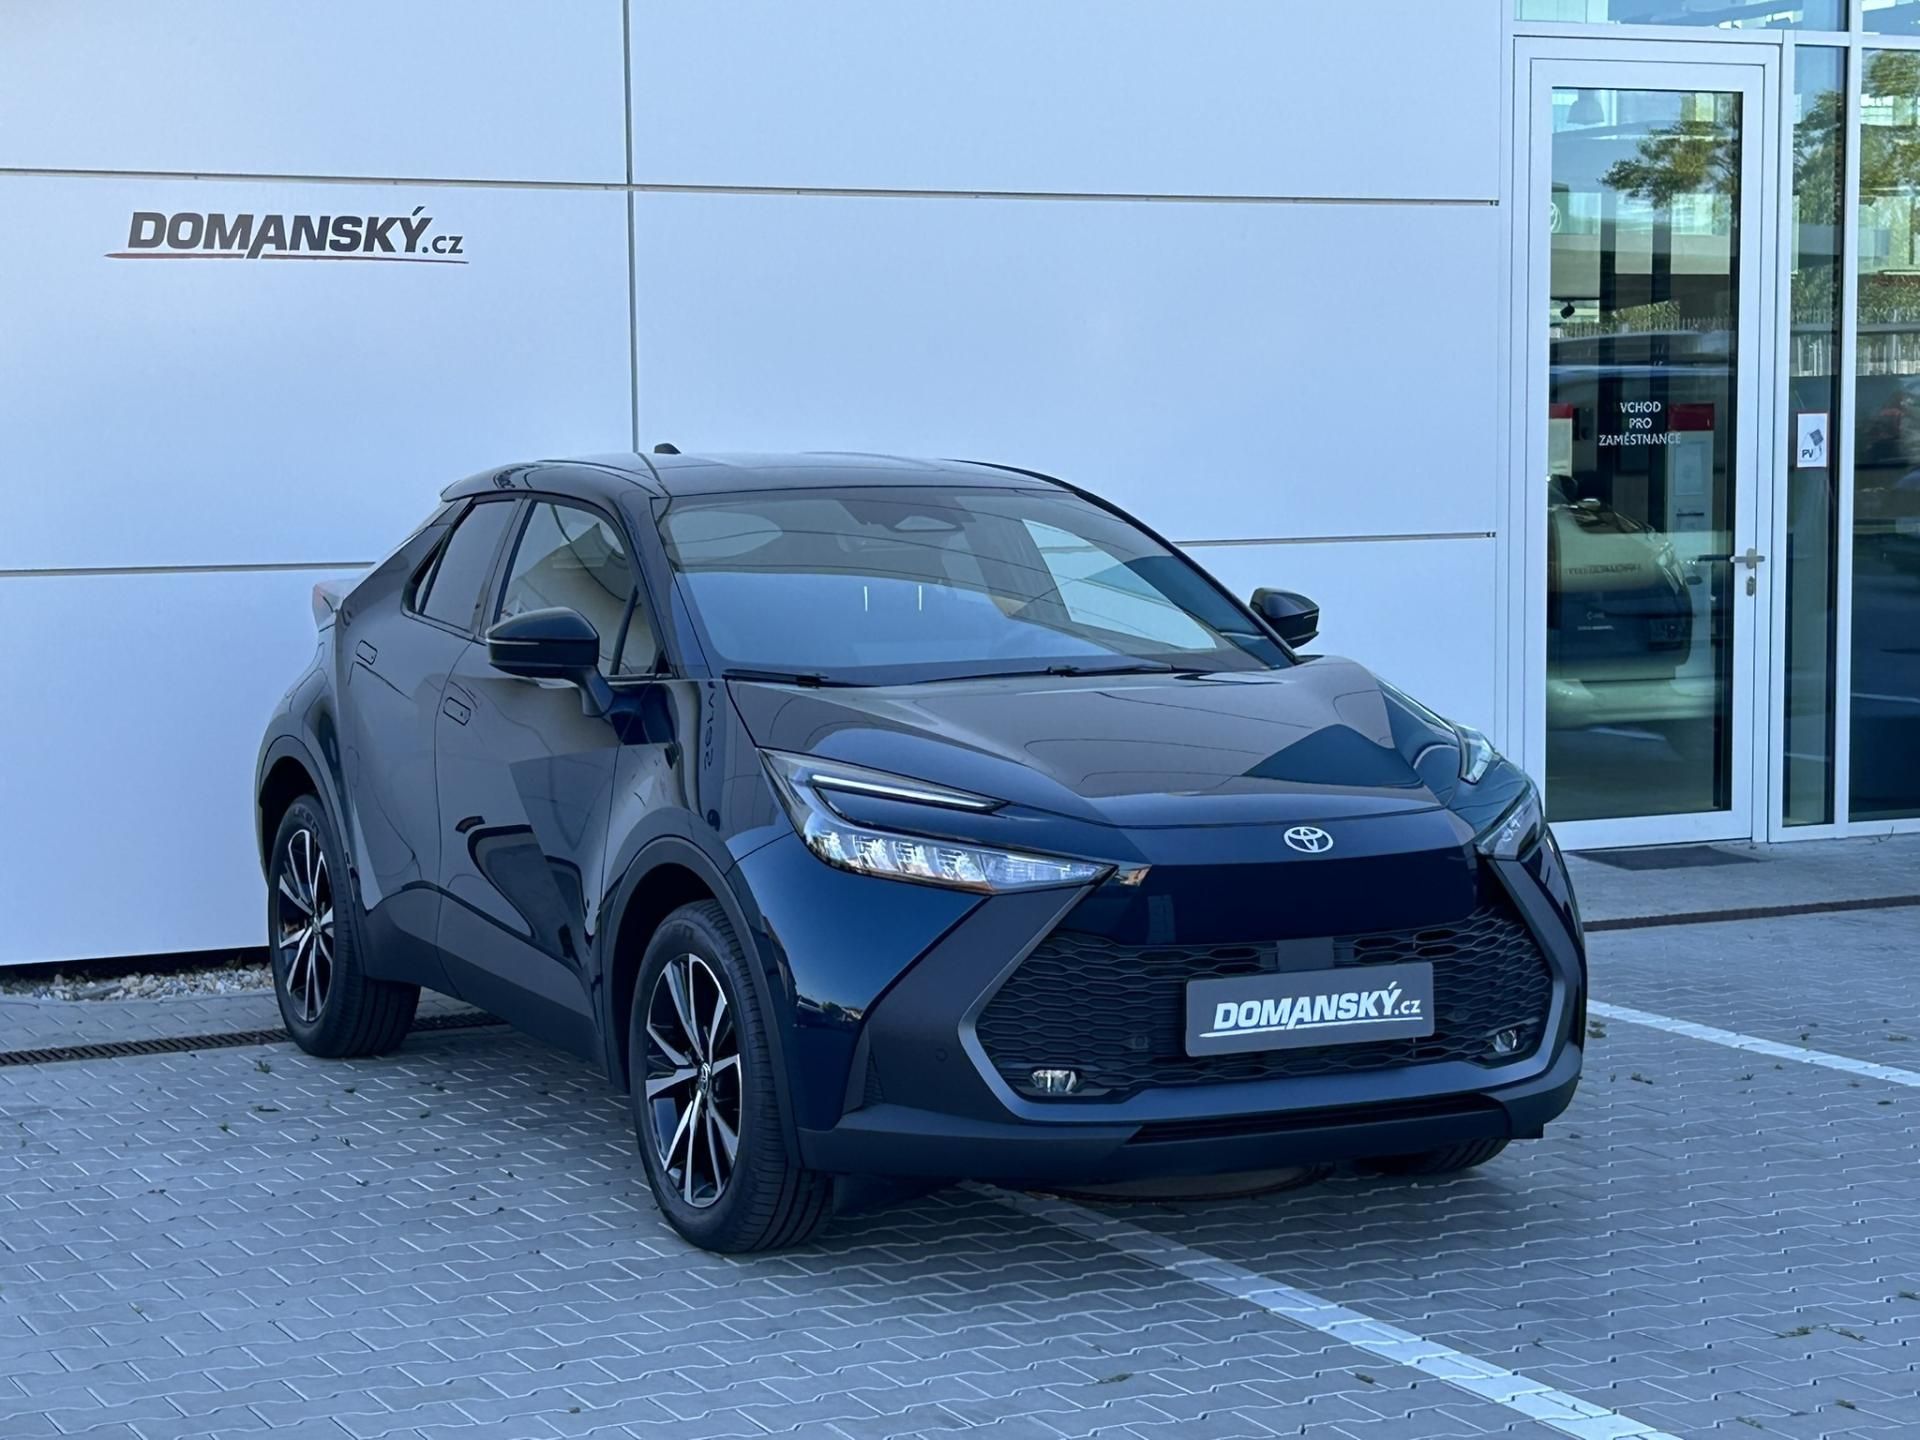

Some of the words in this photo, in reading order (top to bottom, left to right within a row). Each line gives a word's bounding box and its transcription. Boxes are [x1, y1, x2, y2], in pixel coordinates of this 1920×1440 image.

[1619, 401, 1661, 413] VCHOD
[1629, 417, 1652, 429] PRO
[1598, 431, 1681, 446] ZAMĚSTNANCE
[1801, 448, 1814, 459] PV
